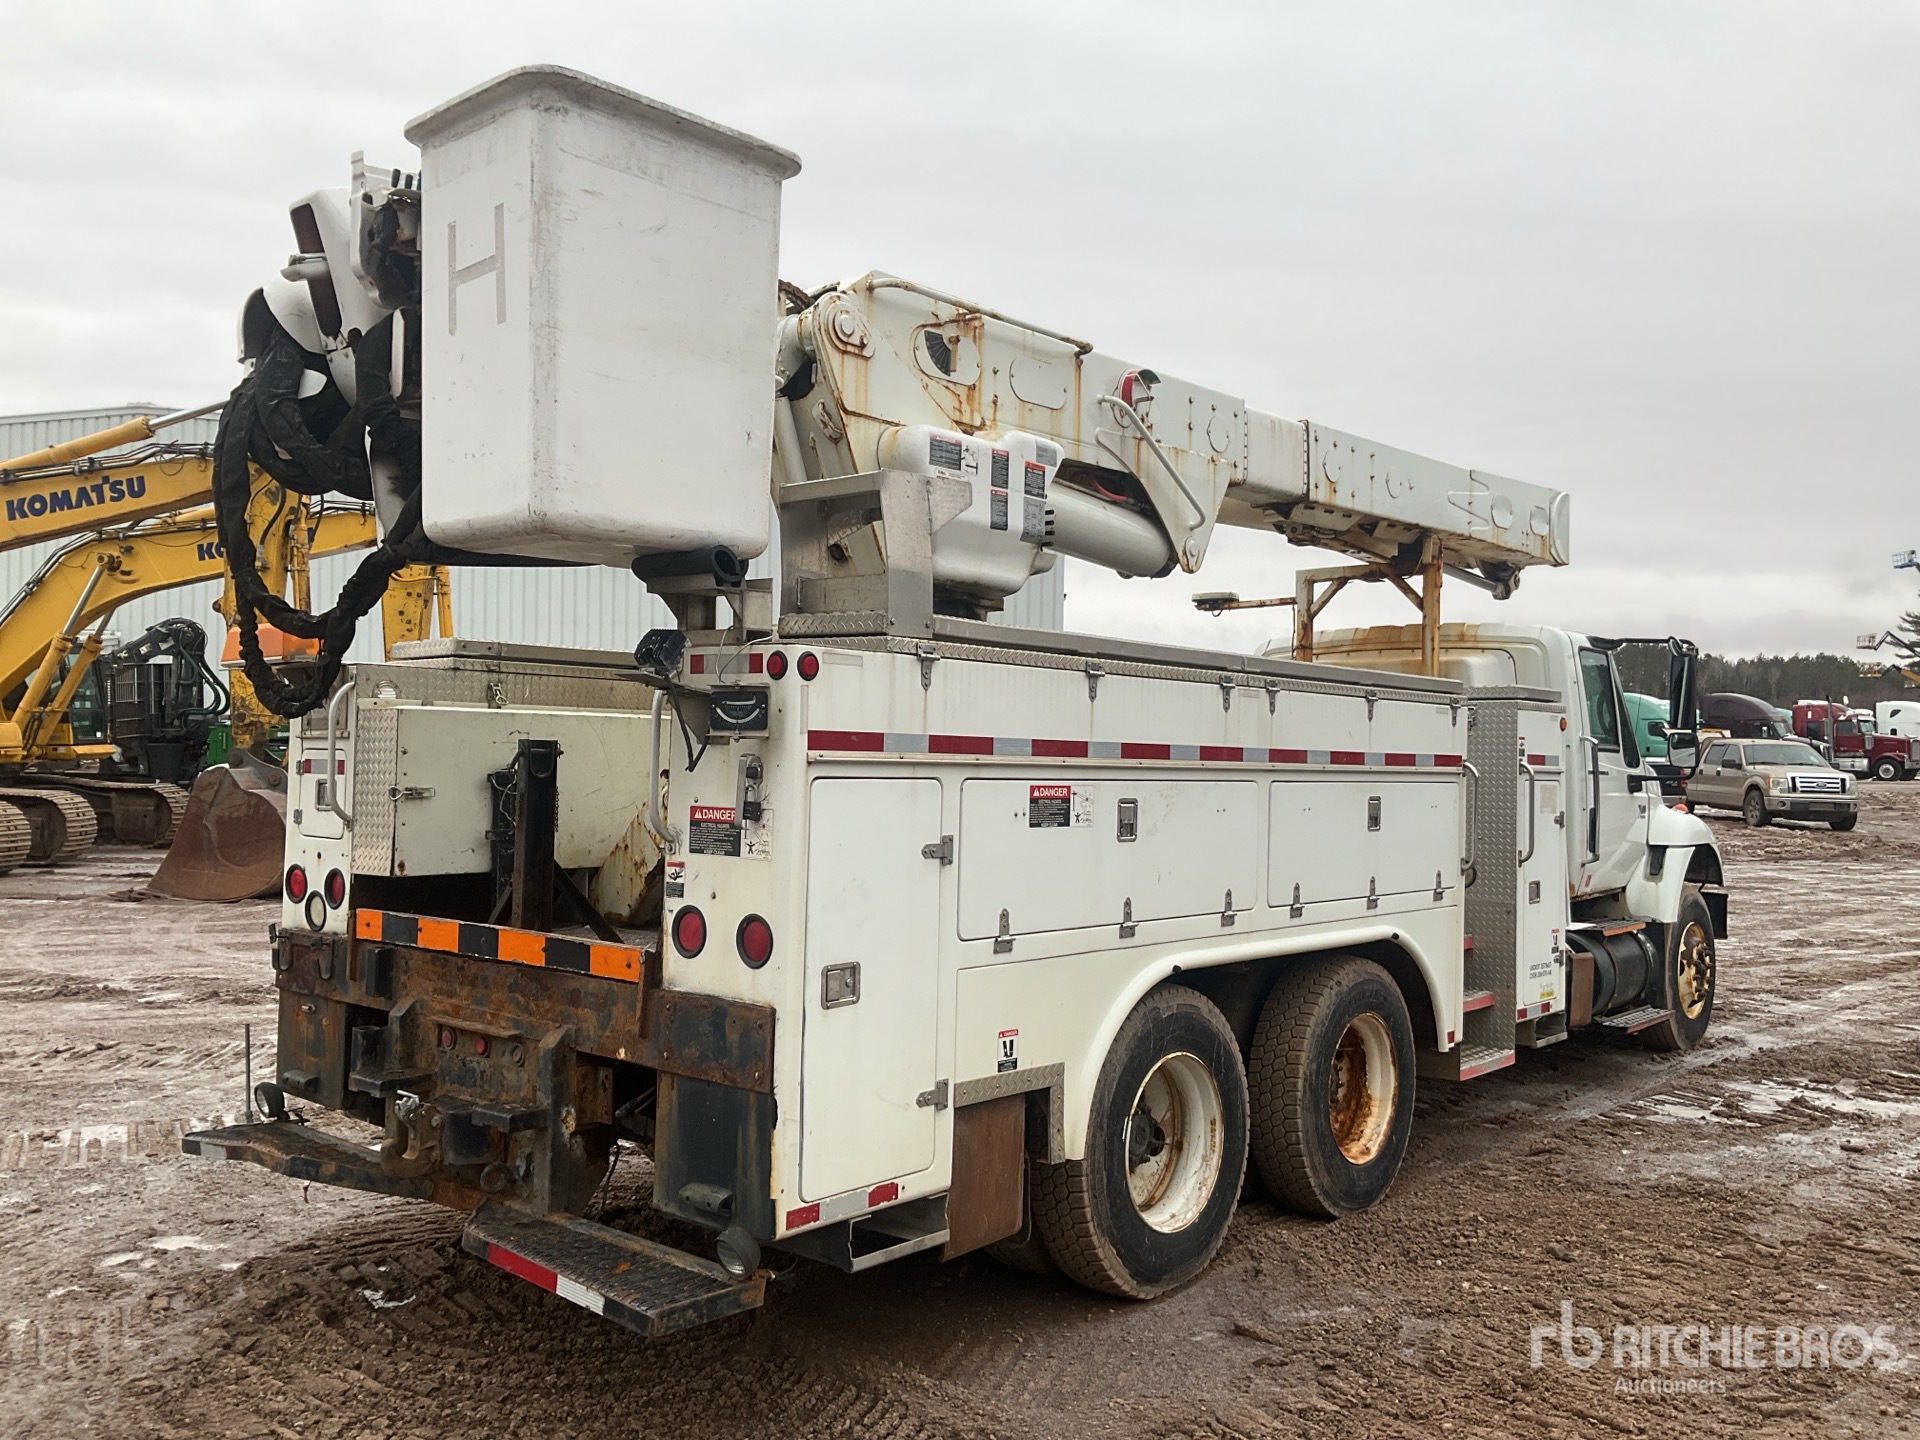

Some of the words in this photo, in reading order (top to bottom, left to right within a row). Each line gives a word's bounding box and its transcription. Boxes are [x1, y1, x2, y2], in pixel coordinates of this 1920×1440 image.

[6, 475, 146, 521] KOMATSU
[1040, 787, 1068, 796] DANGER
[702, 809, 736, 820] DANGER
